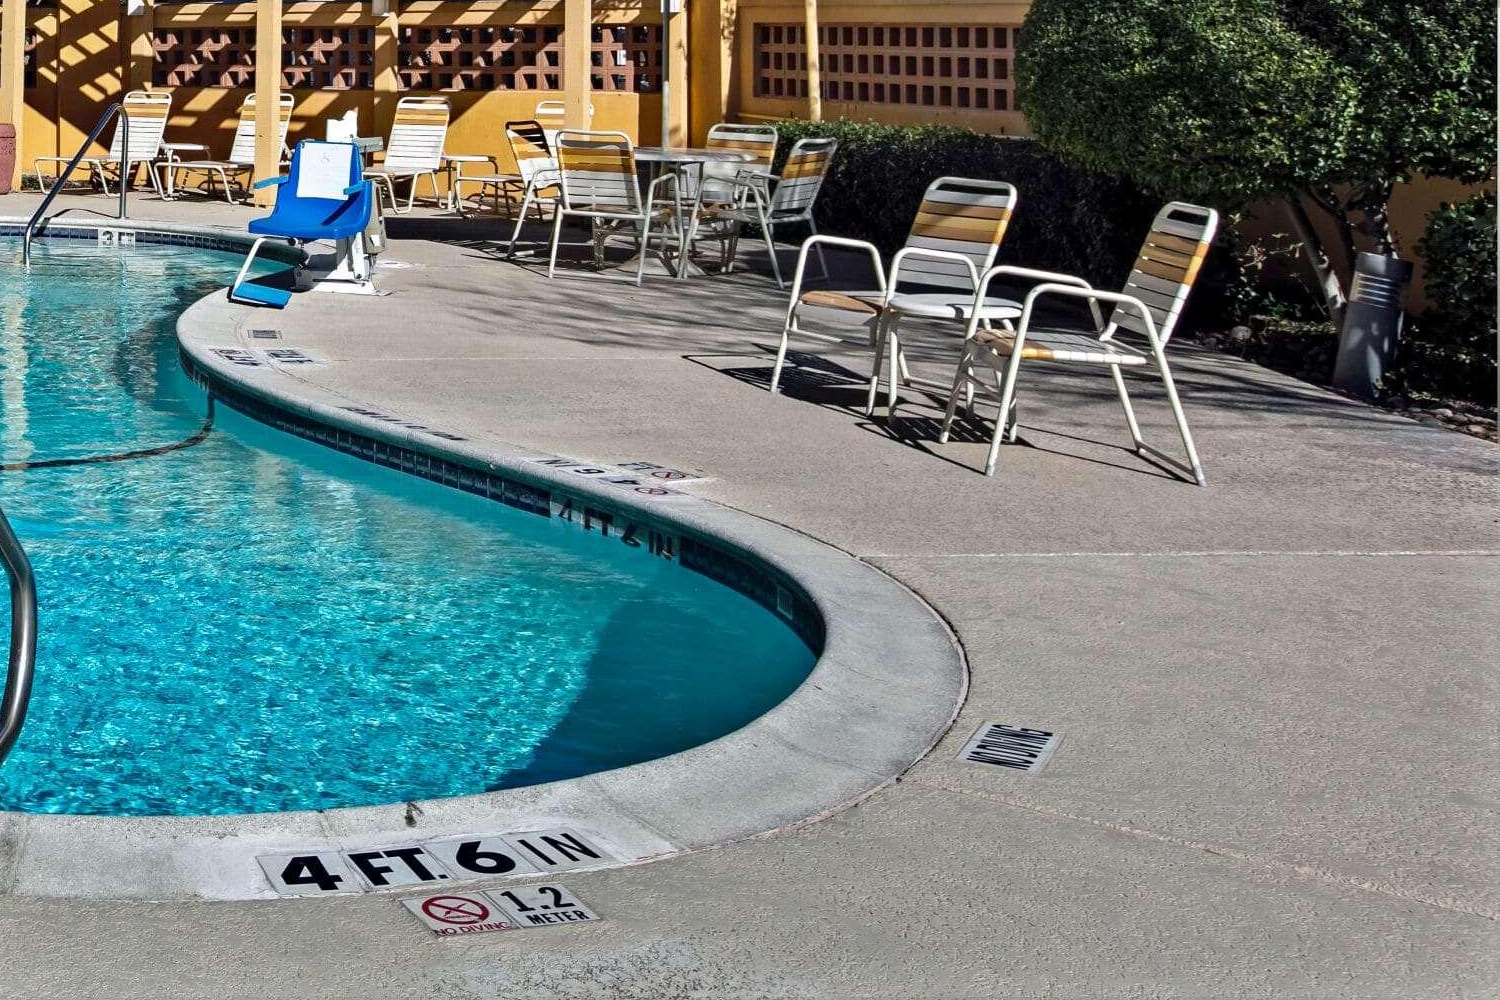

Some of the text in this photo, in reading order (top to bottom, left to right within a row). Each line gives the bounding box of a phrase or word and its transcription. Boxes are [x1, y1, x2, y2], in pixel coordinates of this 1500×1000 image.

[102, 231, 114, 246] 3
[281, 855, 343, 891] 4
[456, 840, 517, 874] 6
[517, 831, 602, 866] IN
[501, 886, 576, 913] 1.2
[526, 910, 591, 926] METER
[432, 926, 457, 937] NO
